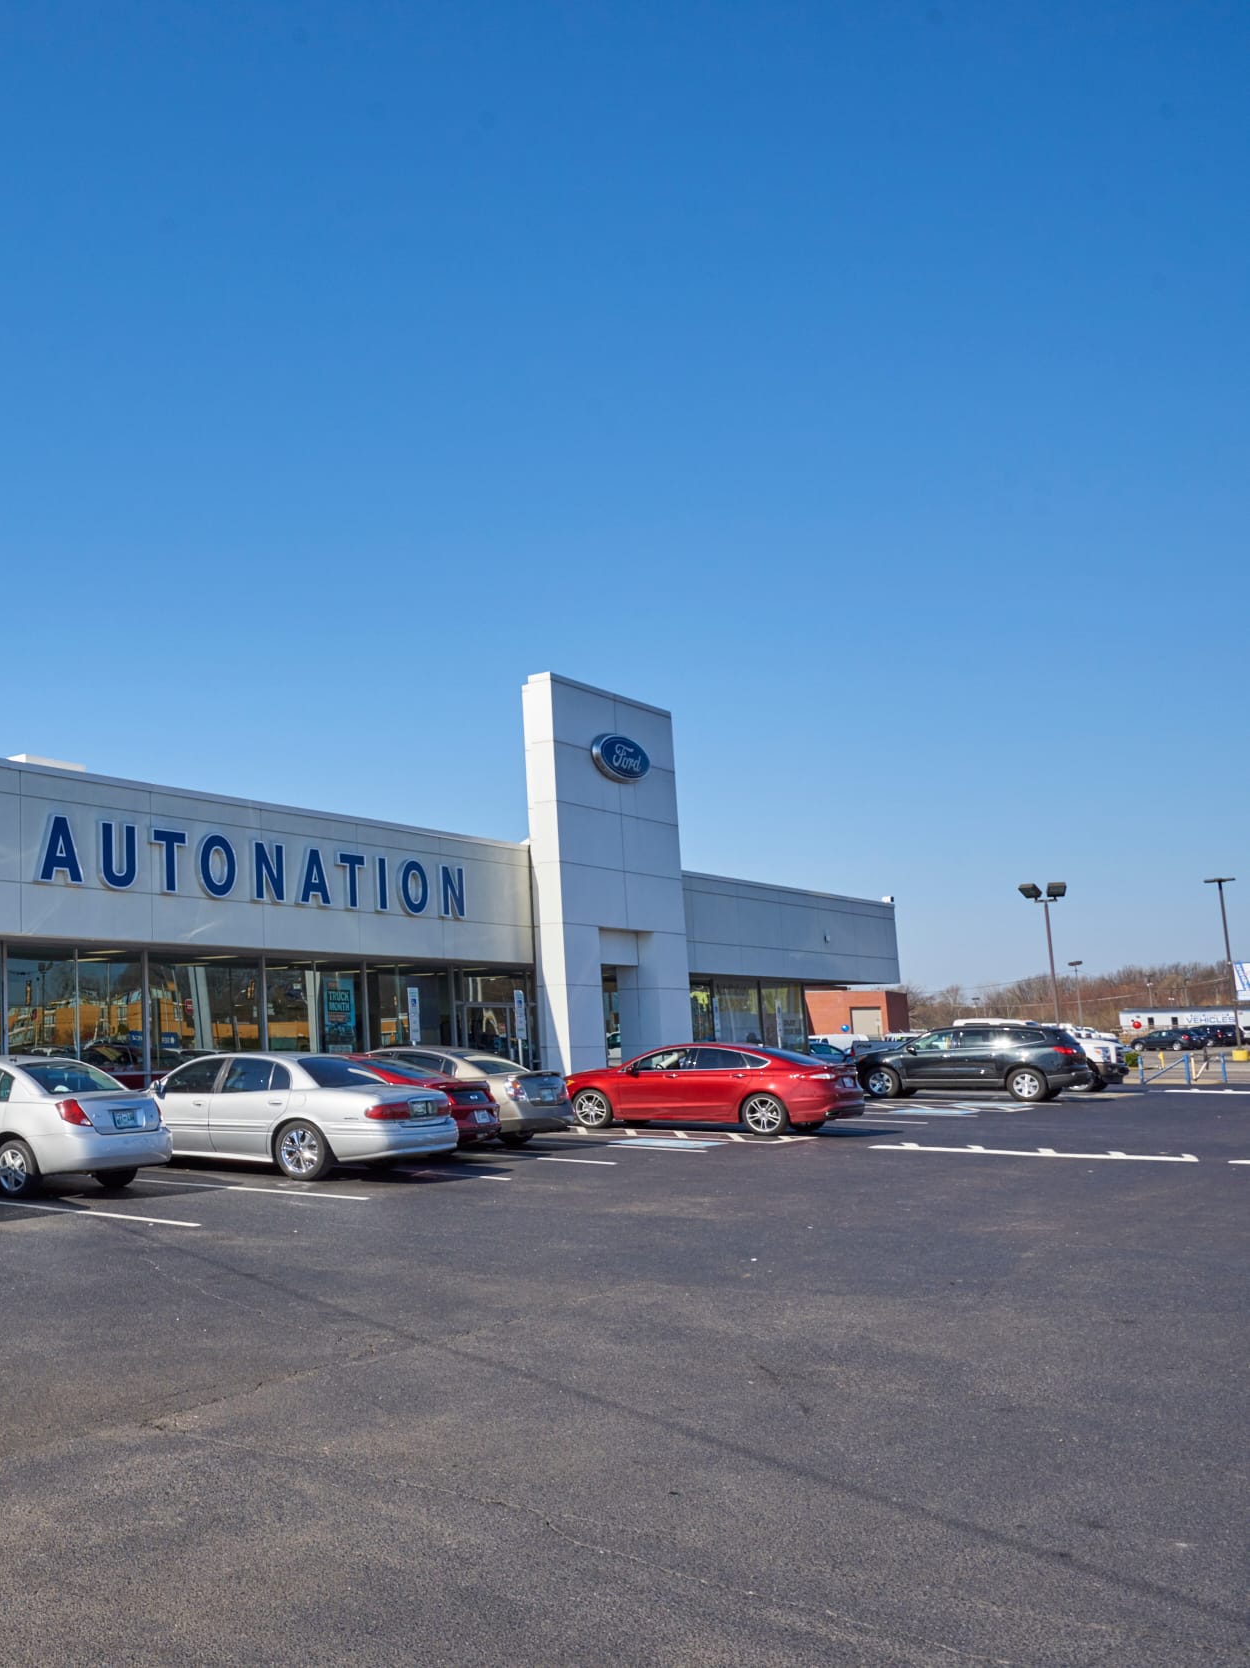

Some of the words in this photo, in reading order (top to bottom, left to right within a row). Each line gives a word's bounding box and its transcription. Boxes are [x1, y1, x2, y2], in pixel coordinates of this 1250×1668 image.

[612, 743, 642, 772] Ford
[34, 814, 467, 919] AUTONATION
[328, 991, 350, 1002] TRUCK
[1186, 1016, 1236, 1024] VEHICLES
